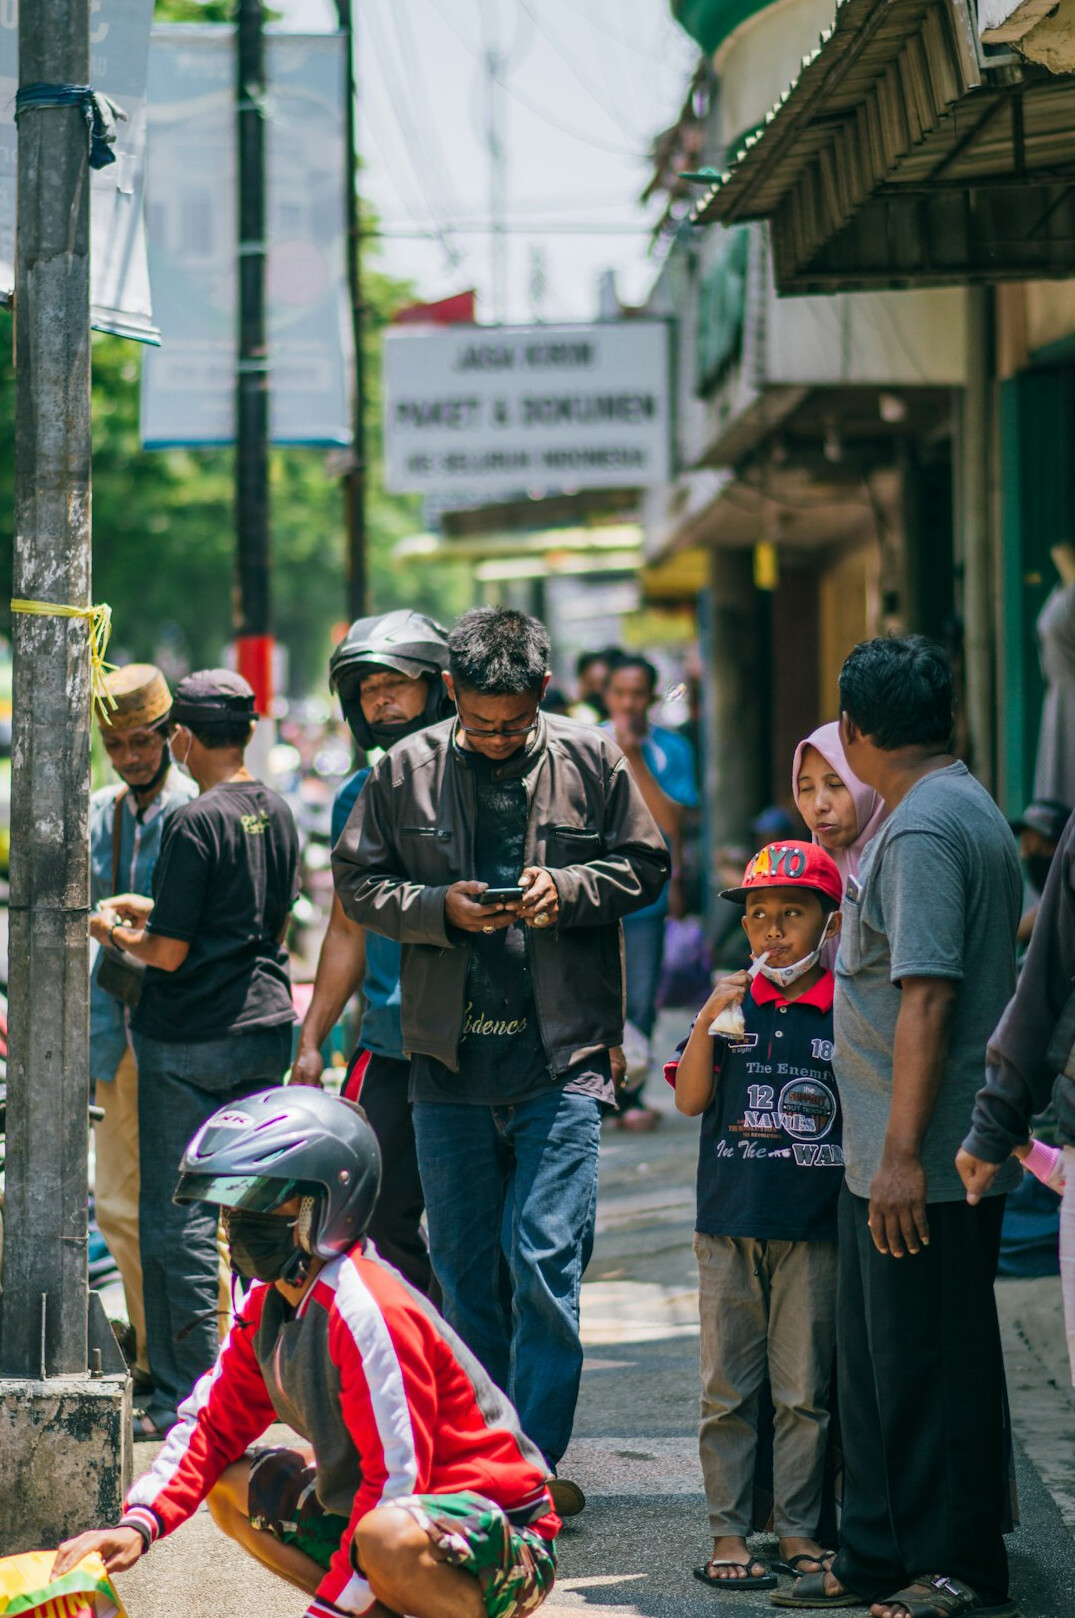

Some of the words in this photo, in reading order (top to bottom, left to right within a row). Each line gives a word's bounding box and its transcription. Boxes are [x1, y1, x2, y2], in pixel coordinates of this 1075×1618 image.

[396, 397, 479, 427] PAKET
[522, 393, 656, 424] DOKUMEN
[542, 448, 644, 469] INDONESIA
[811, 1038, 834, 1061] 18
[746, 1061, 773, 1074] The
[747, 1084, 774, 1110] 12
[716, 1139, 734, 1158] In
[738, 1140, 768, 1159] The
